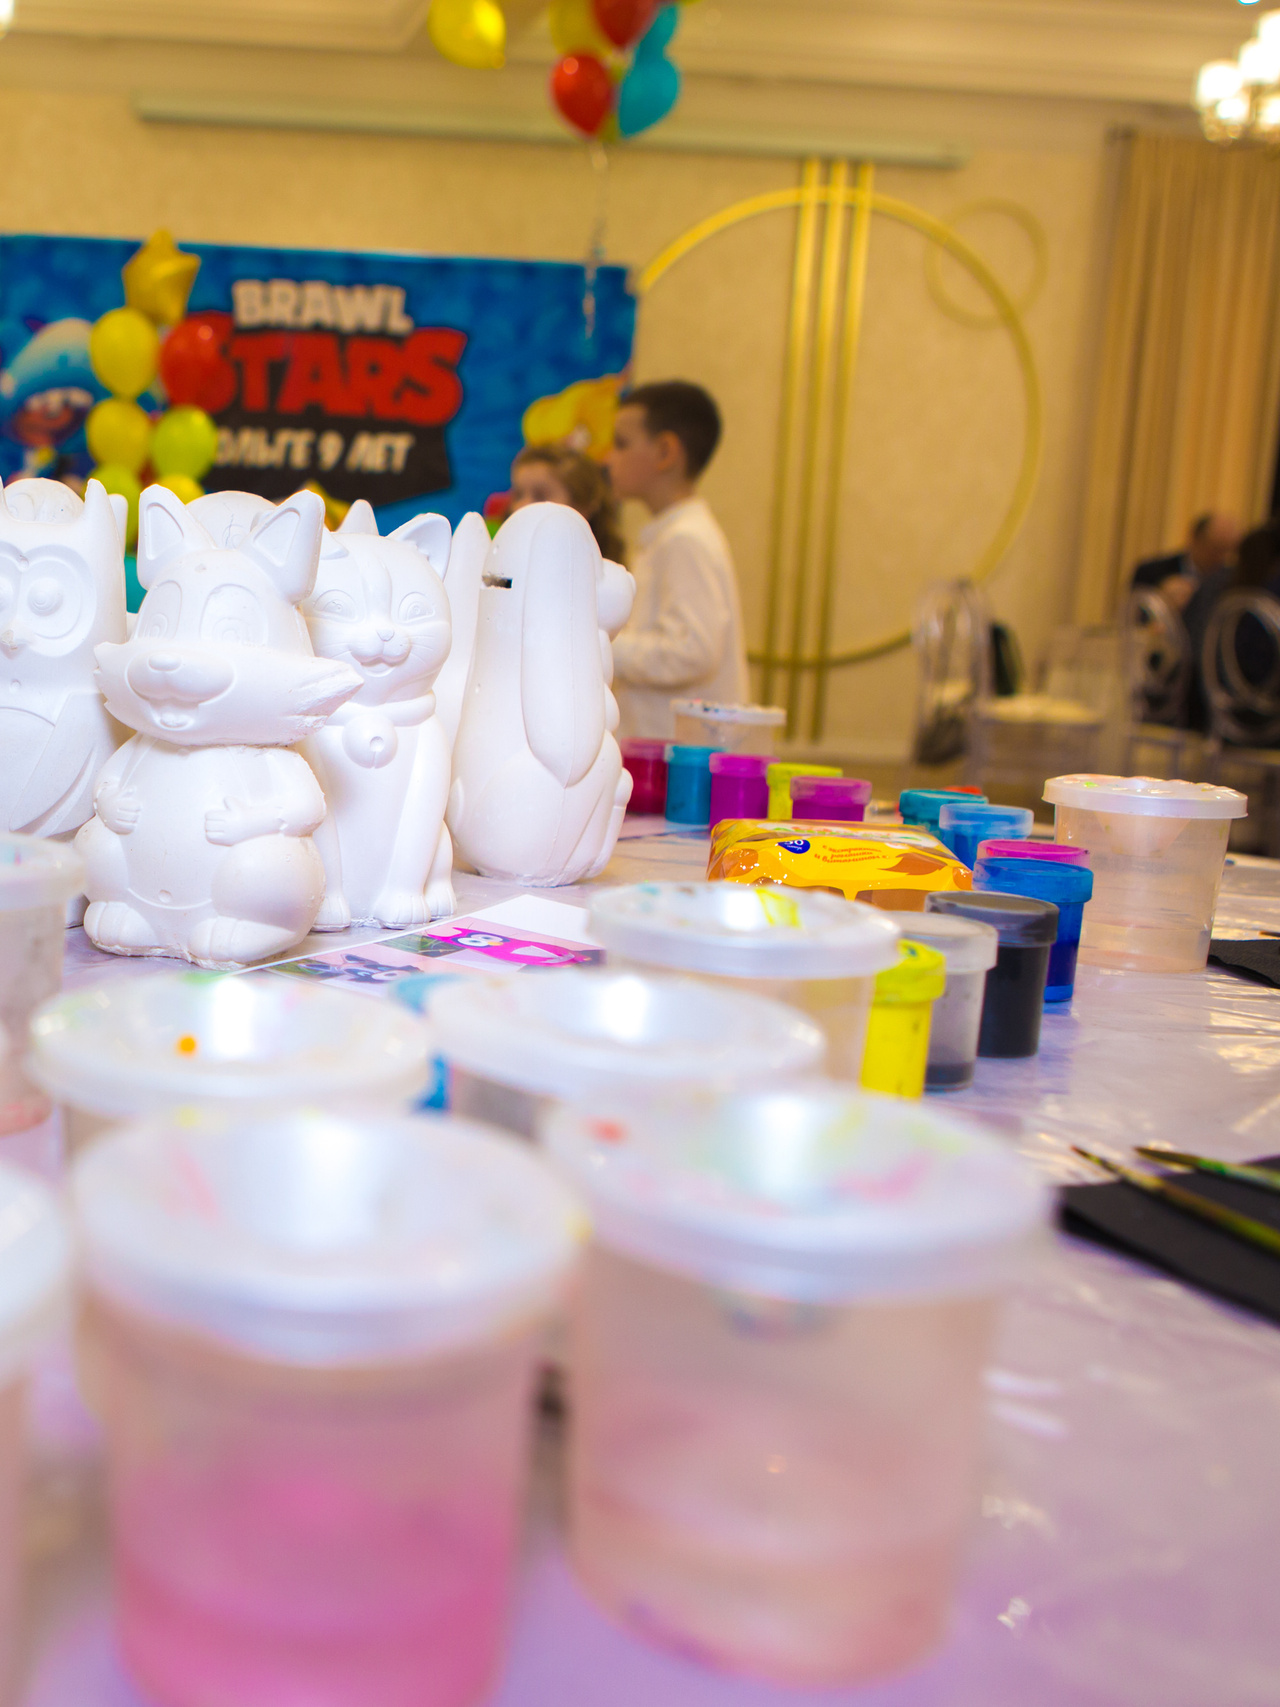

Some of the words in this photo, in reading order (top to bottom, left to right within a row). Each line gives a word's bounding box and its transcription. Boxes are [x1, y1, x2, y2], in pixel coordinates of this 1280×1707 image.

[231, 279, 414, 336] BRAWL
[318, 430, 346, 471] 9
[347, 430, 416, 473] ЛЕТ
